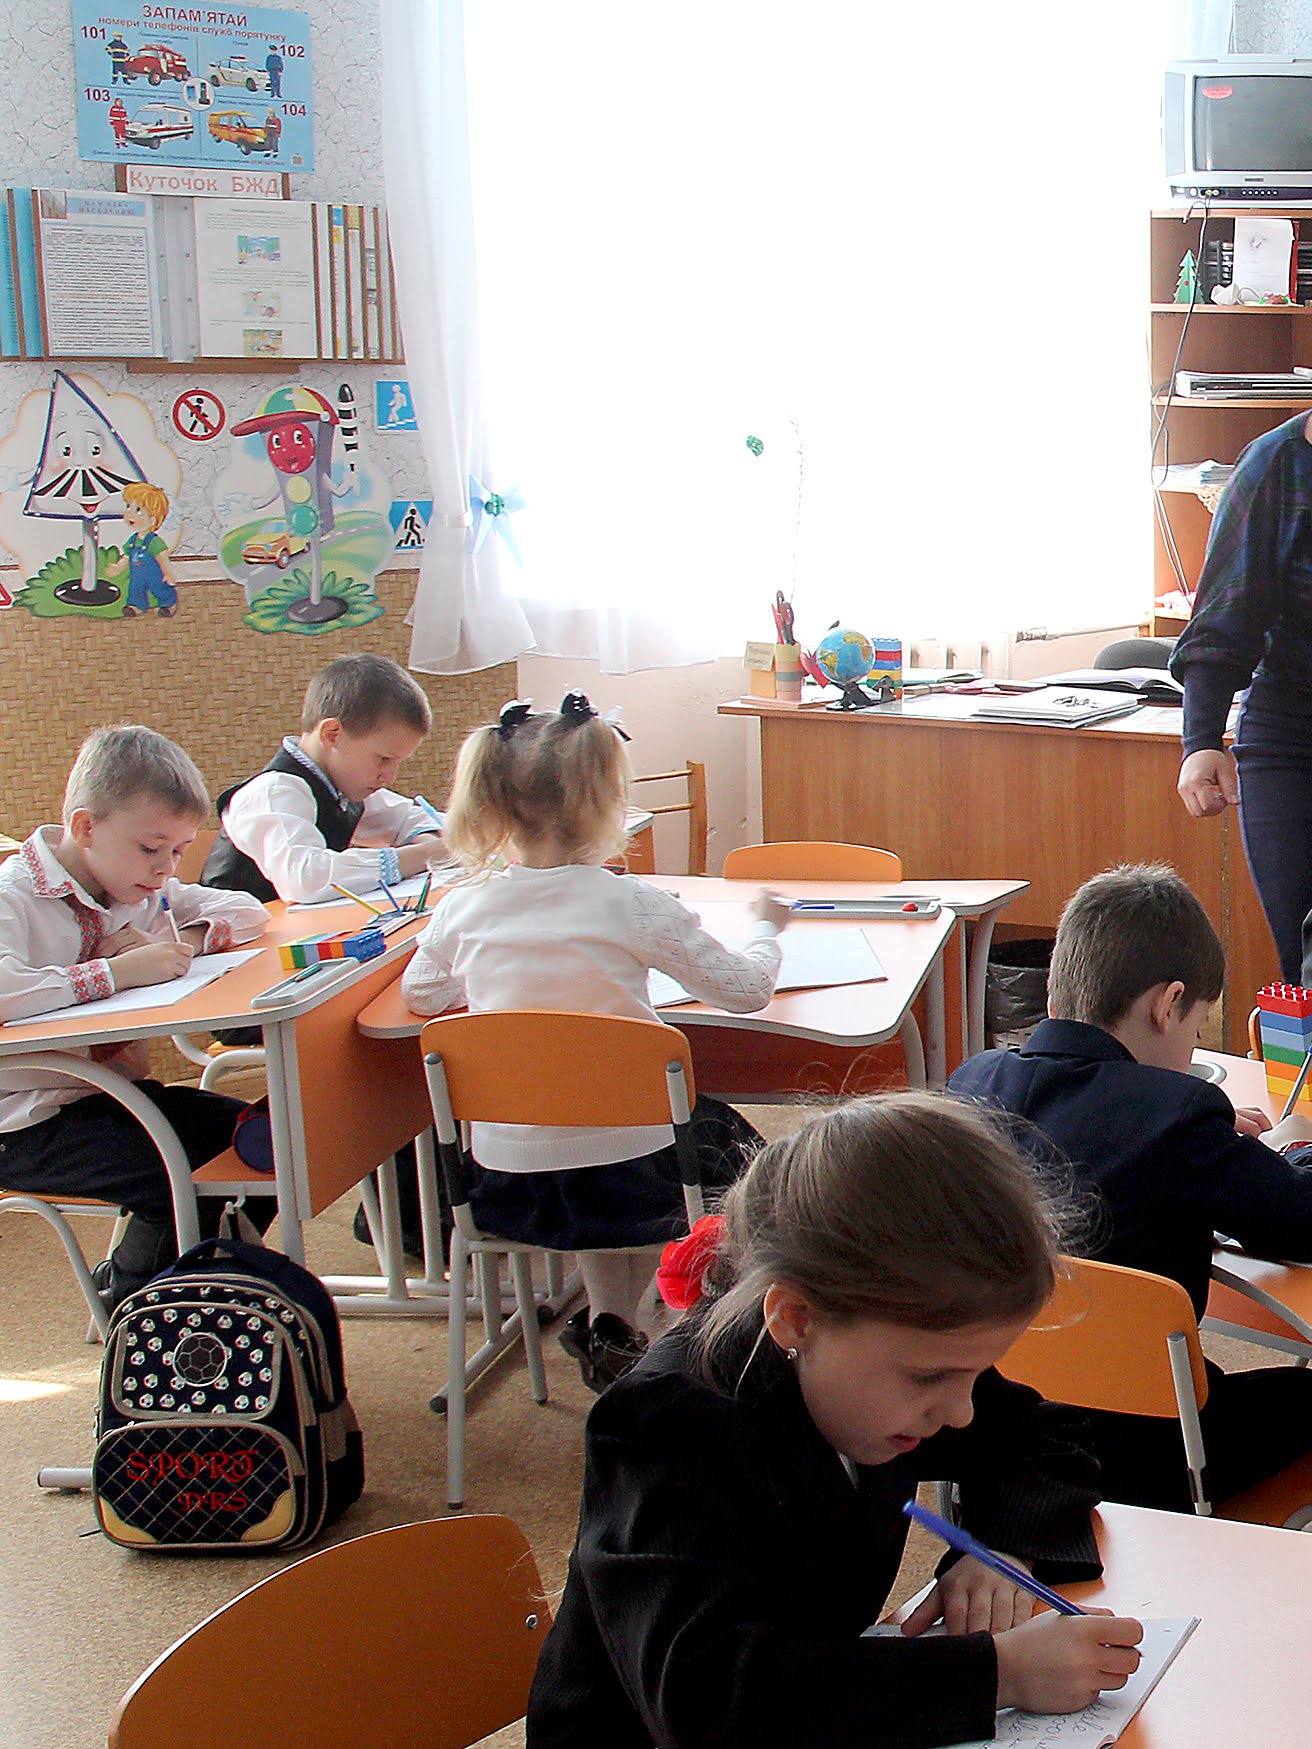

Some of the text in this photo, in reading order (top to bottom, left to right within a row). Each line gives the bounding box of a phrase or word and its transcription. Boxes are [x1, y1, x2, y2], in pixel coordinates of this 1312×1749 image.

[81, 26, 106, 39] 101
[98, 17, 139, 28] номери
[144, 20, 199, 33] телефонів
[202, 26, 232, 37] служб
[235, 29, 286, 43] порятунку
[280, 44, 305, 58] 102
[84, 88, 111, 102] 103
[281, 103, 307, 116] 104
[129, 170, 281, 196] Куточок БЖД
[126, 1449, 260, 1487] SPORT
